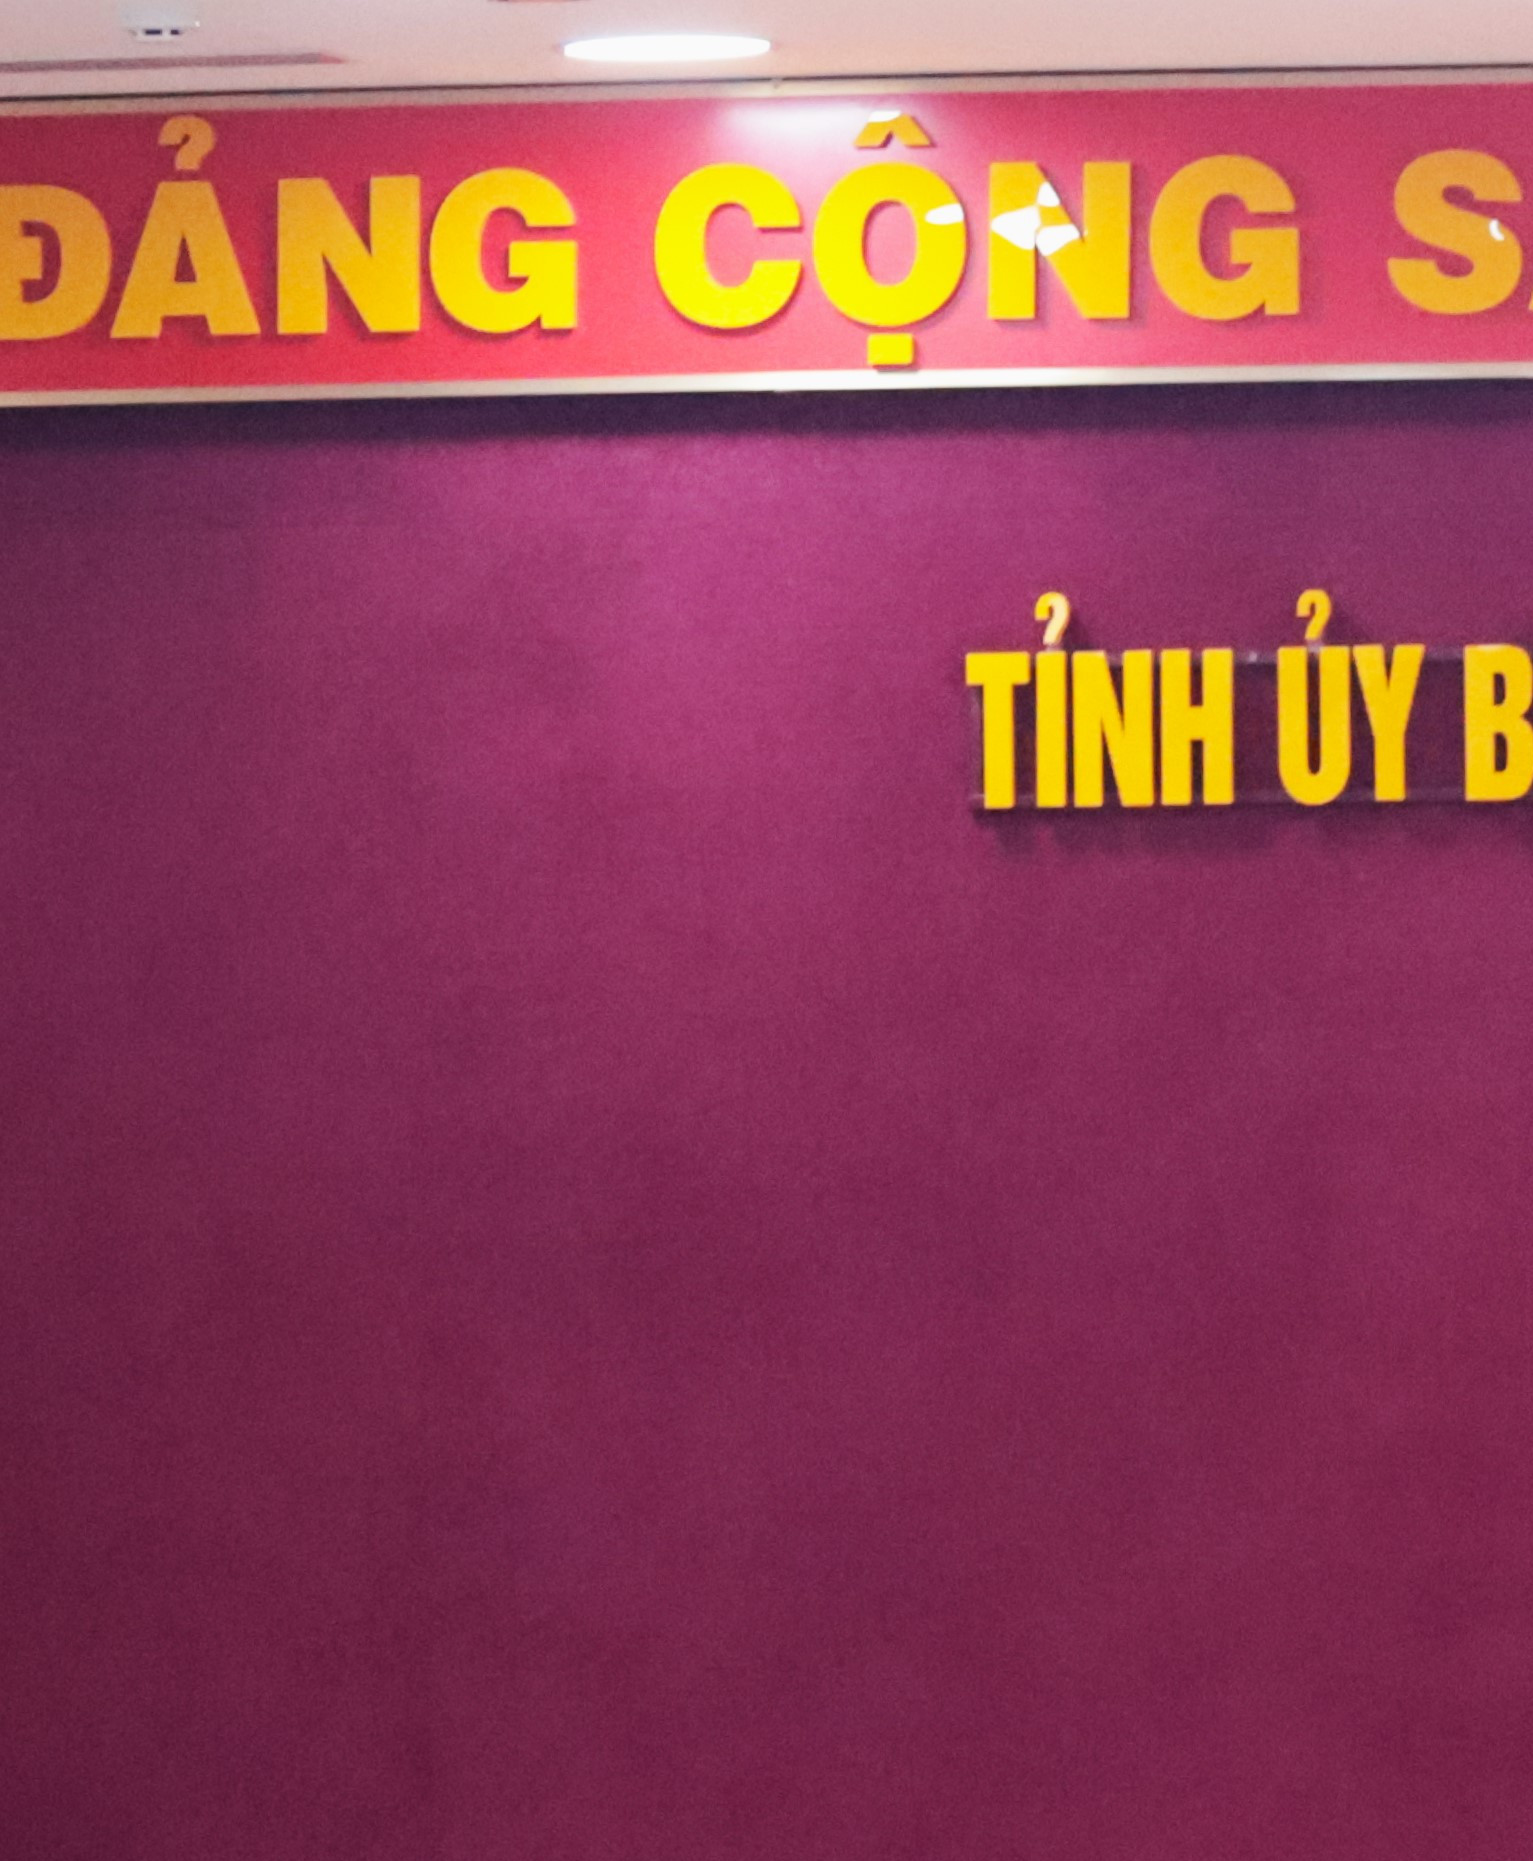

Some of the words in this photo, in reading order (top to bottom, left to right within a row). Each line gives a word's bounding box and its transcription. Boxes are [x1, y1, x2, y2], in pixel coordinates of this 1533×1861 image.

[0, 114, 578, 340] ĐẢNG
[653, 110, 1300, 366] CỘNG
[965, 592, 1235, 809] TỈNH
[1277, 589, 1425, 805] ỦY
